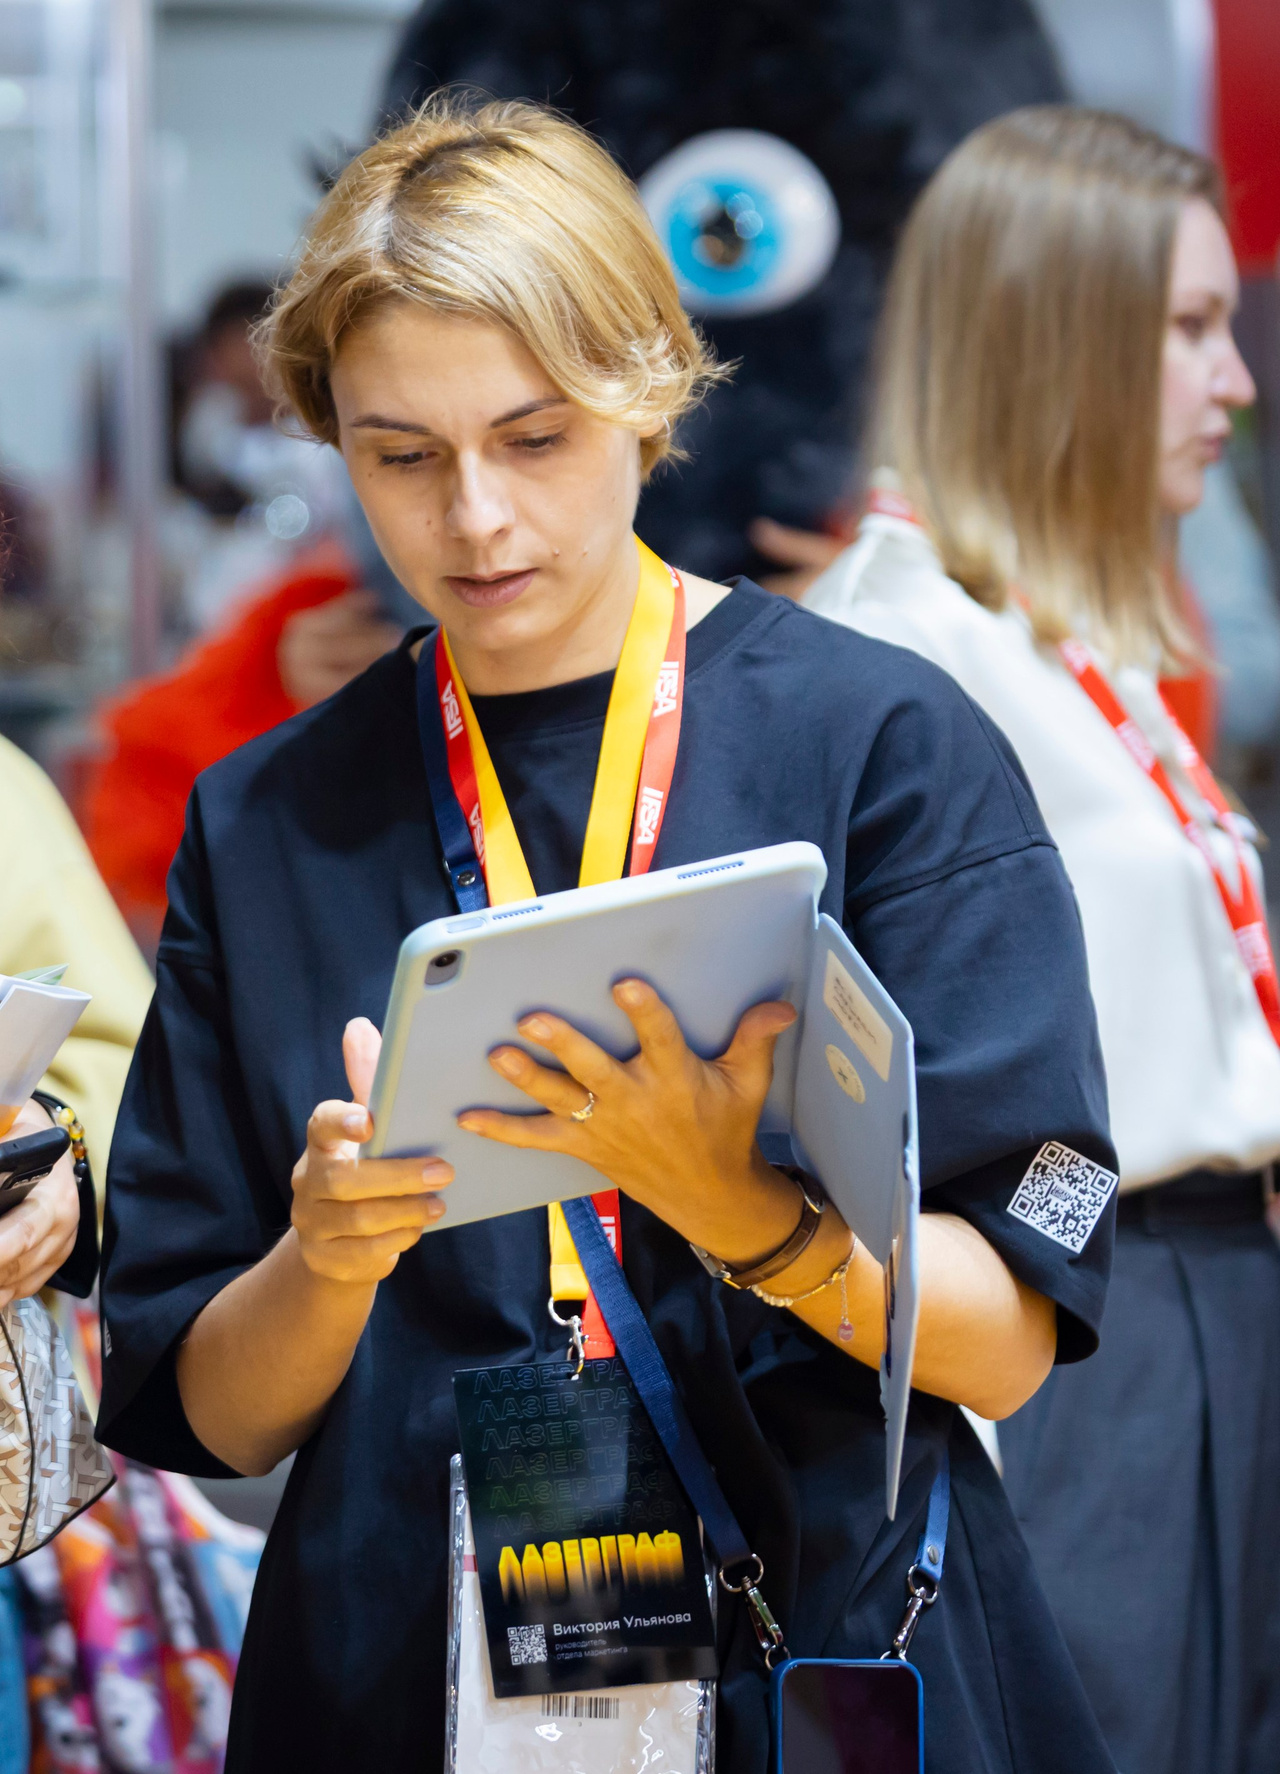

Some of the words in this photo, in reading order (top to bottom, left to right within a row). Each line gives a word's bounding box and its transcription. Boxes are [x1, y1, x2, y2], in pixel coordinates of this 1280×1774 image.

[653, 661, 680, 718] IPSA
[637, 786, 664, 844] IPSA
[498, 1529, 683, 1575] ЛАЗЕРГРАФ
[553, 1620, 620, 1636] Виктория
[623, 1612, 692, 1628] Ульянова
[554, 1639, 607, 1651] руководитель
